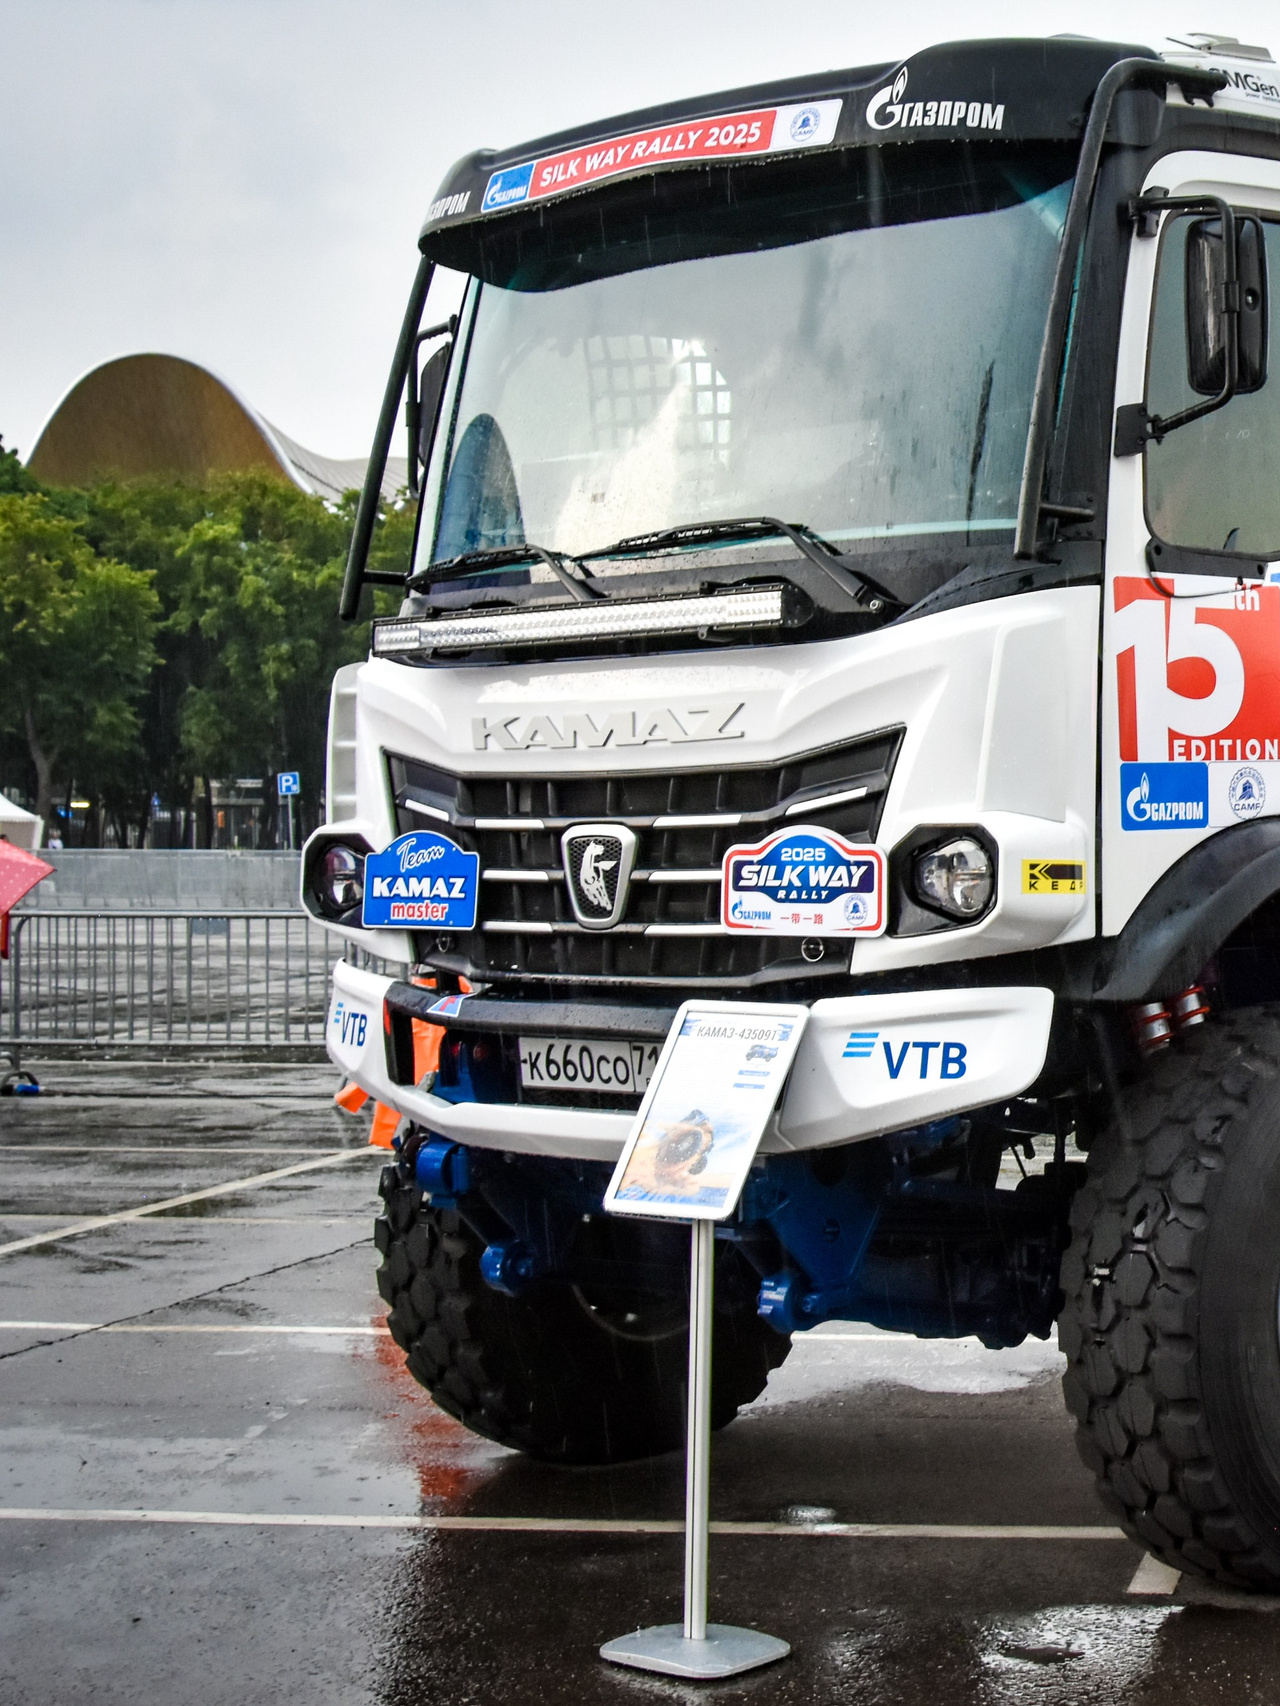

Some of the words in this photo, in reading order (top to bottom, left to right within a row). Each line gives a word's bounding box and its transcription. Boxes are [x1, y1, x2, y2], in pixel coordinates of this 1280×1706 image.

[900, 101, 1005, 131] ГАЗПРОМ
[540, 158, 583, 187] SILK
[585, 144, 632, 173] WAY
[630, 129, 703, 160] RALLY
[704, 121, 762, 147] 2025
[471, 702, 746, 751] KAMAZ
[1173, 739, 1279, 760] EDITION
[1151, 801, 1203, 822] GAZPROM
[1234, 803, 1260, 811] CAMF
[397, 837, 445, 873] Team
[781, 847, 826, 861] 2025
[738, 865, 806, 887] SILK
[808, 865, 869, 888] WAY
[373, 877, 466, 898] KAMAZ
[777, 890, 829, 900] RALLY
[390, 900, 449, 920] master
[743, 910, 771, 920] GAZPROM
[342, 1011, 368, 1047] VTB
[882, 1041, 968, 1079] VTB
